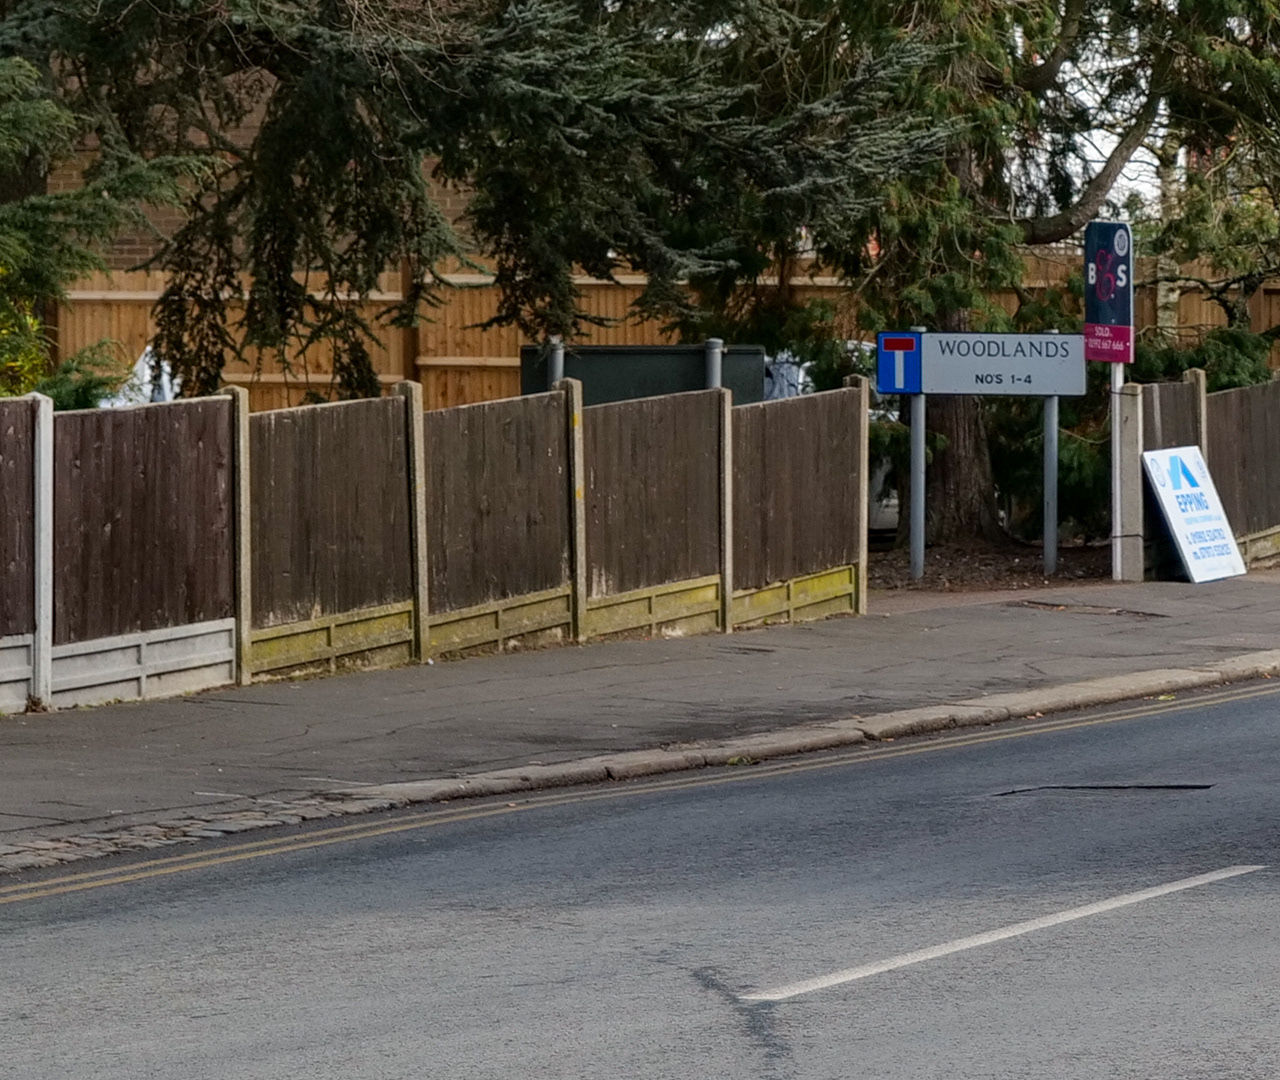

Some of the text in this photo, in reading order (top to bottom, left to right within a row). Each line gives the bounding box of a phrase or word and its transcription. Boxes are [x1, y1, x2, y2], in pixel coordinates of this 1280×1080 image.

[938, 340, 1069, 358] WOODLANDS
[1011, 374, 1032, 384] 1-4
[1175, 491, 1209, 513] EPPING
